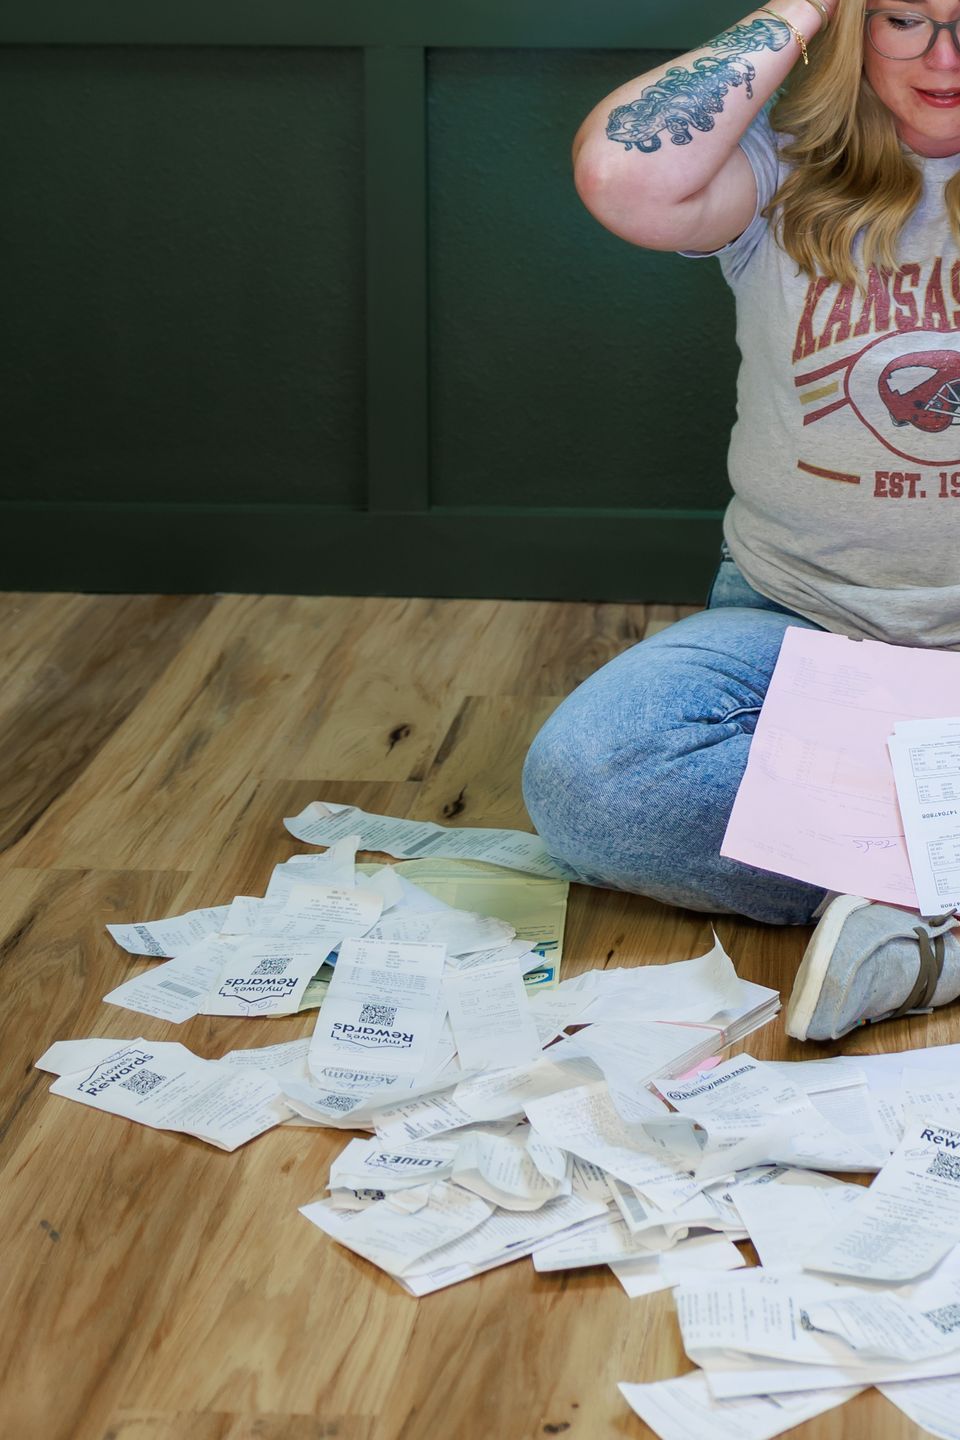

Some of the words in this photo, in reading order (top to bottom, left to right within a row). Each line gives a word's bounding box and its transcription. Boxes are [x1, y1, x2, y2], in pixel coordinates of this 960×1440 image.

[873, 470, 927, 498] EST.
[224, 977, 297, 986] Rewards
[233, 985, 282, 993] mylowe's
[333, 1022, 415, 1043] Rewards
[346, 1032, 401, 1046] mylowe's
[85, 1055, 153, 1098] Rewards
[89, 1055, 132, 1086] mylowe's
[320, 1067, 396, 1084] Academy
